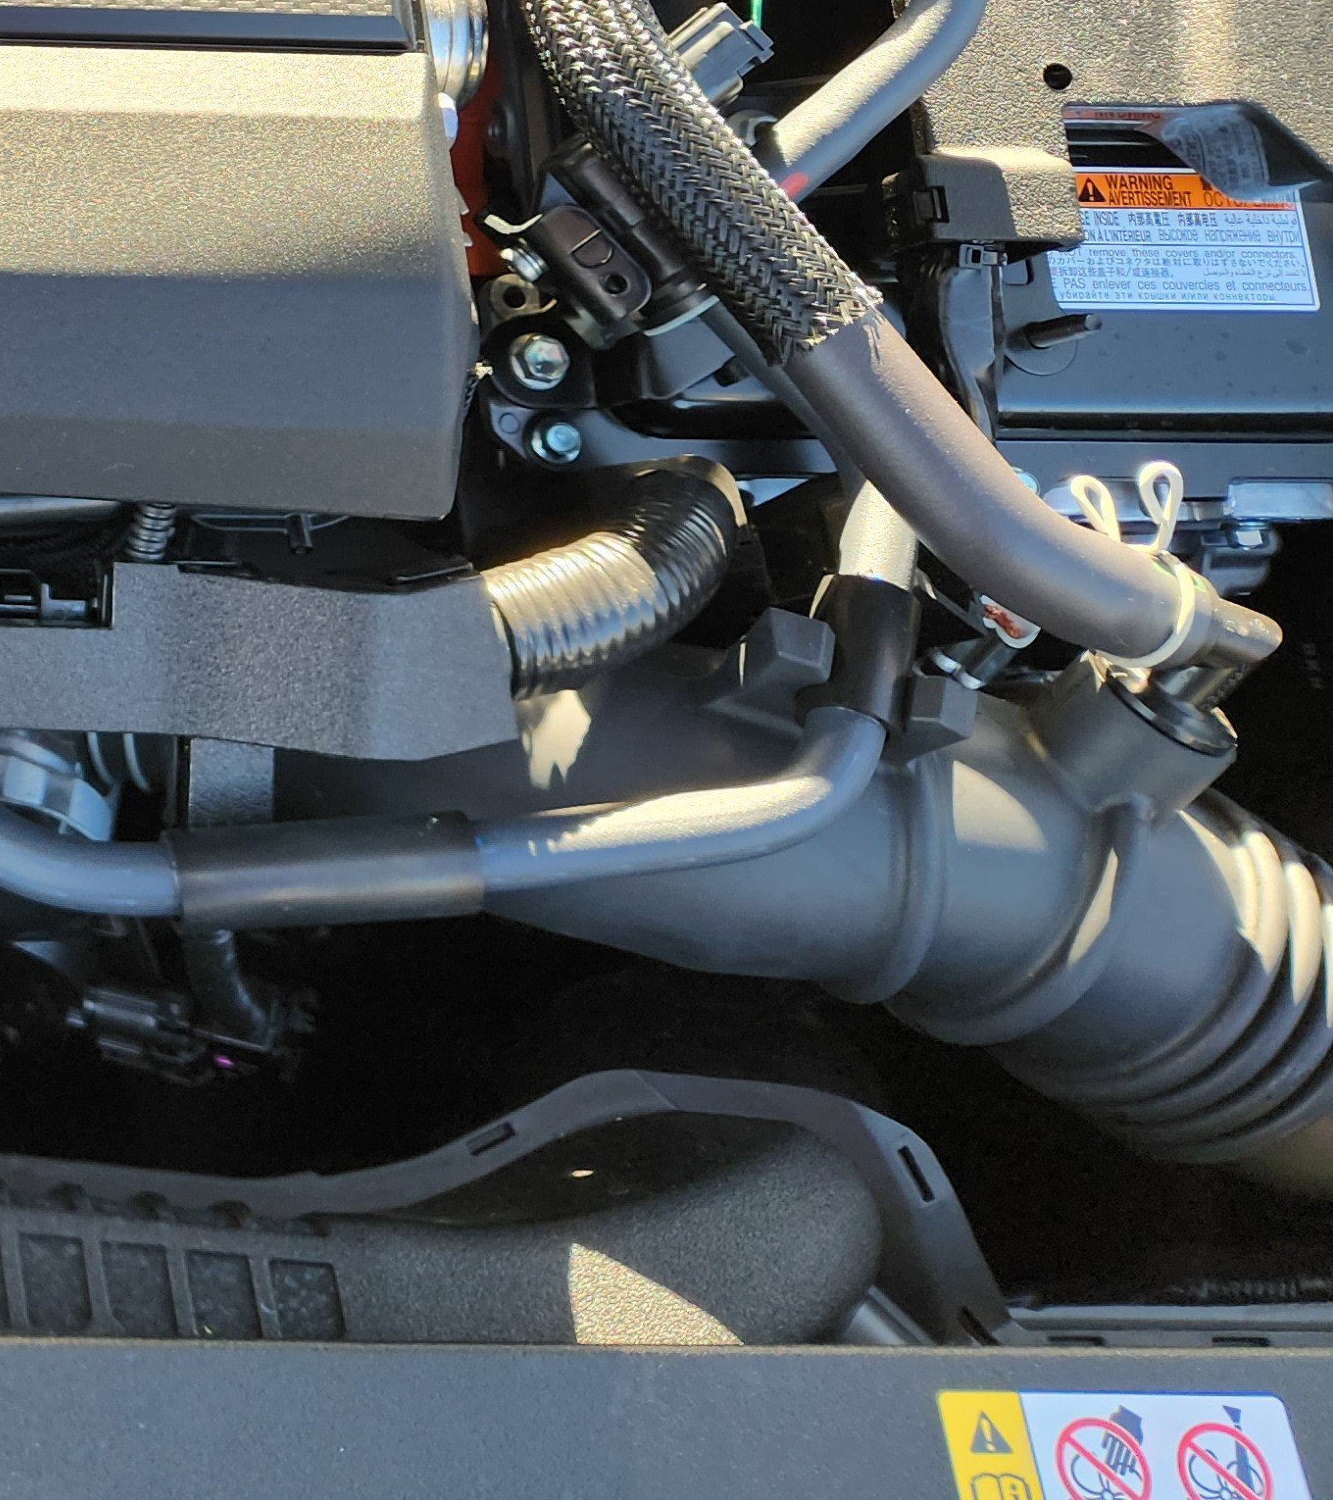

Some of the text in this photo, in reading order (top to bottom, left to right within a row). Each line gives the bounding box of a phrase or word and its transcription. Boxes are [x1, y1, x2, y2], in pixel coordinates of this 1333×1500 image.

[1105, 175, 1173, 190] WARNING
[1108, 191, 1191, 206] AVERTISSEMENT
[1094, 211, 1119, 227] INSIDE
[1089, 248, 1127, 258] remove
[1132, 247, 1160, 258] these
[1165, 249, 1198, 259] covers
[1064, 278, 1086, 289] PAS
[1093, 278, 1131, 290] enlever
[1137, 280, 1157, 290] ces
[1163, 280, 1220, 291] couvercles
[1226, 281, 1237, 291] et
